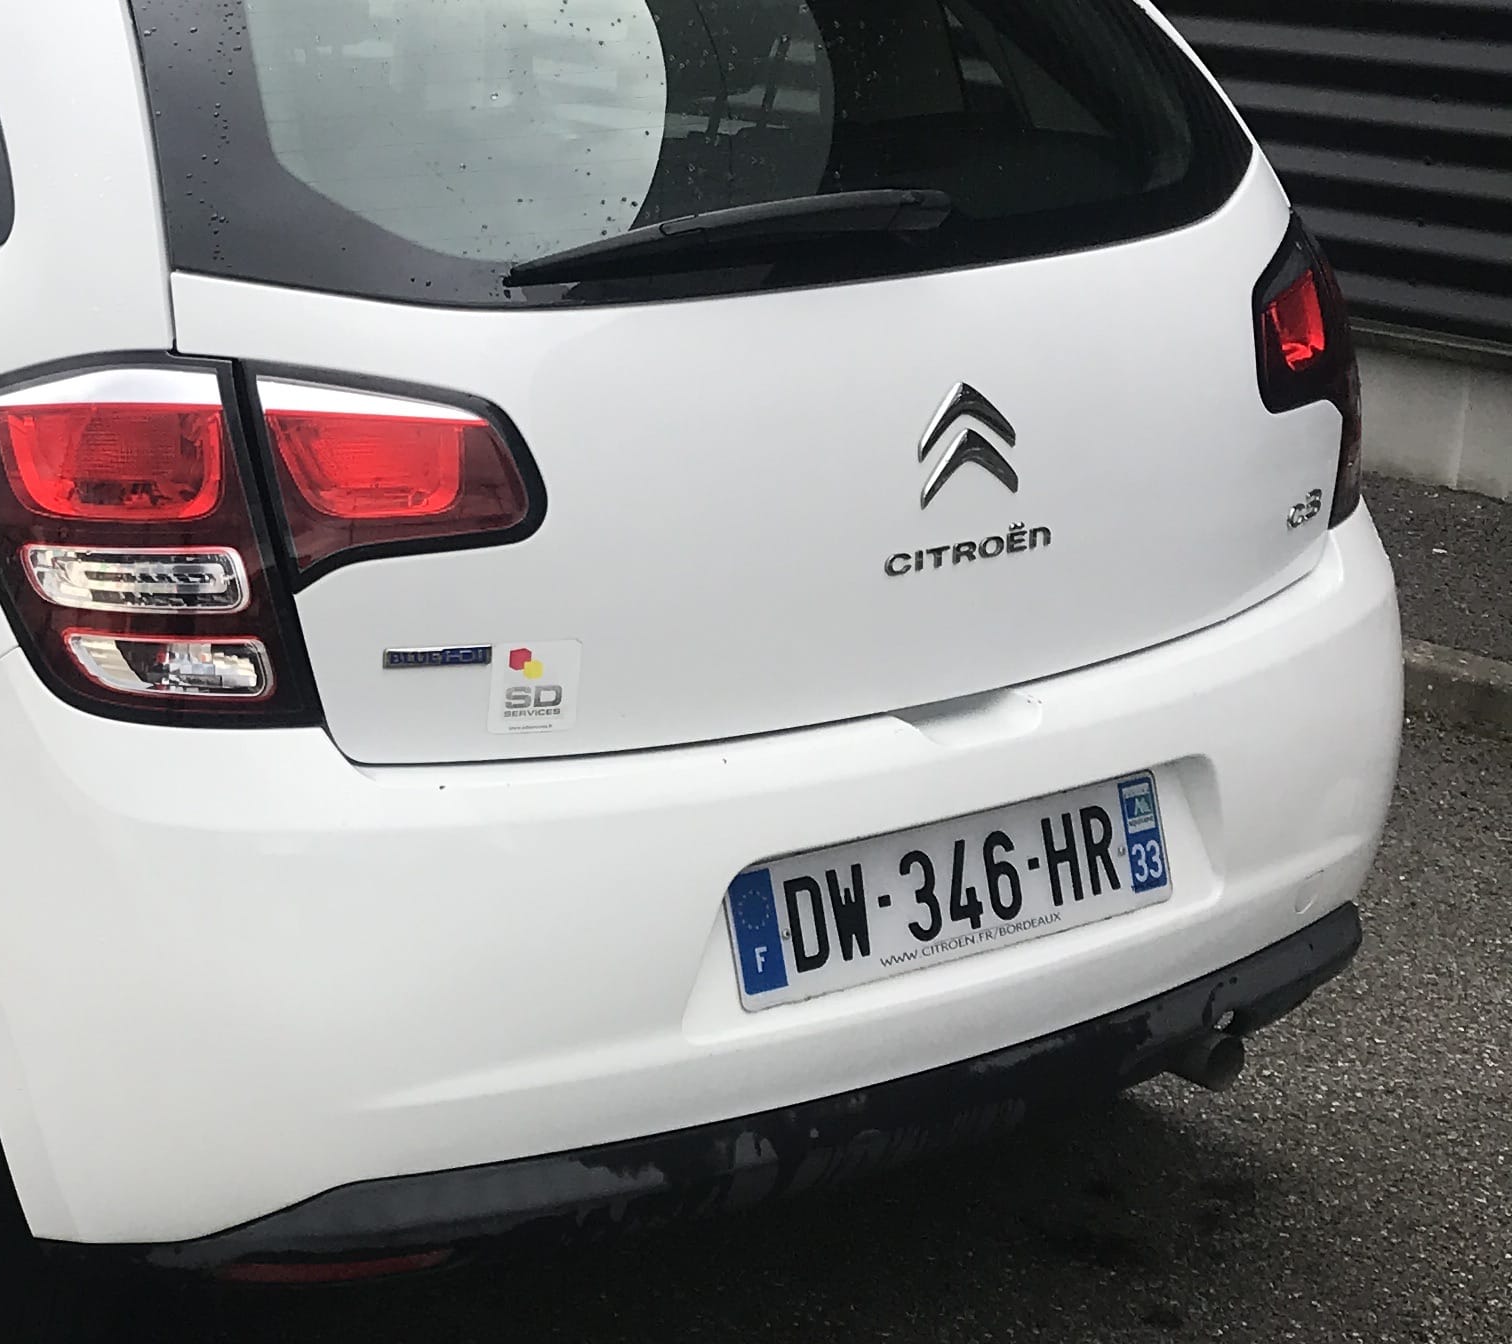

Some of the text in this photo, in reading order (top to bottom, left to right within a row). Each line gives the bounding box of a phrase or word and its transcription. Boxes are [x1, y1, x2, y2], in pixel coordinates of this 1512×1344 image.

[504, 685, 563, 709] SD
[503, 708, 561, 718] SERVICES
[1131, 839, 1164, 883] 33
[782, 805, 1122, 974] DW-346-HR
[753, 945, 769, 975] F
